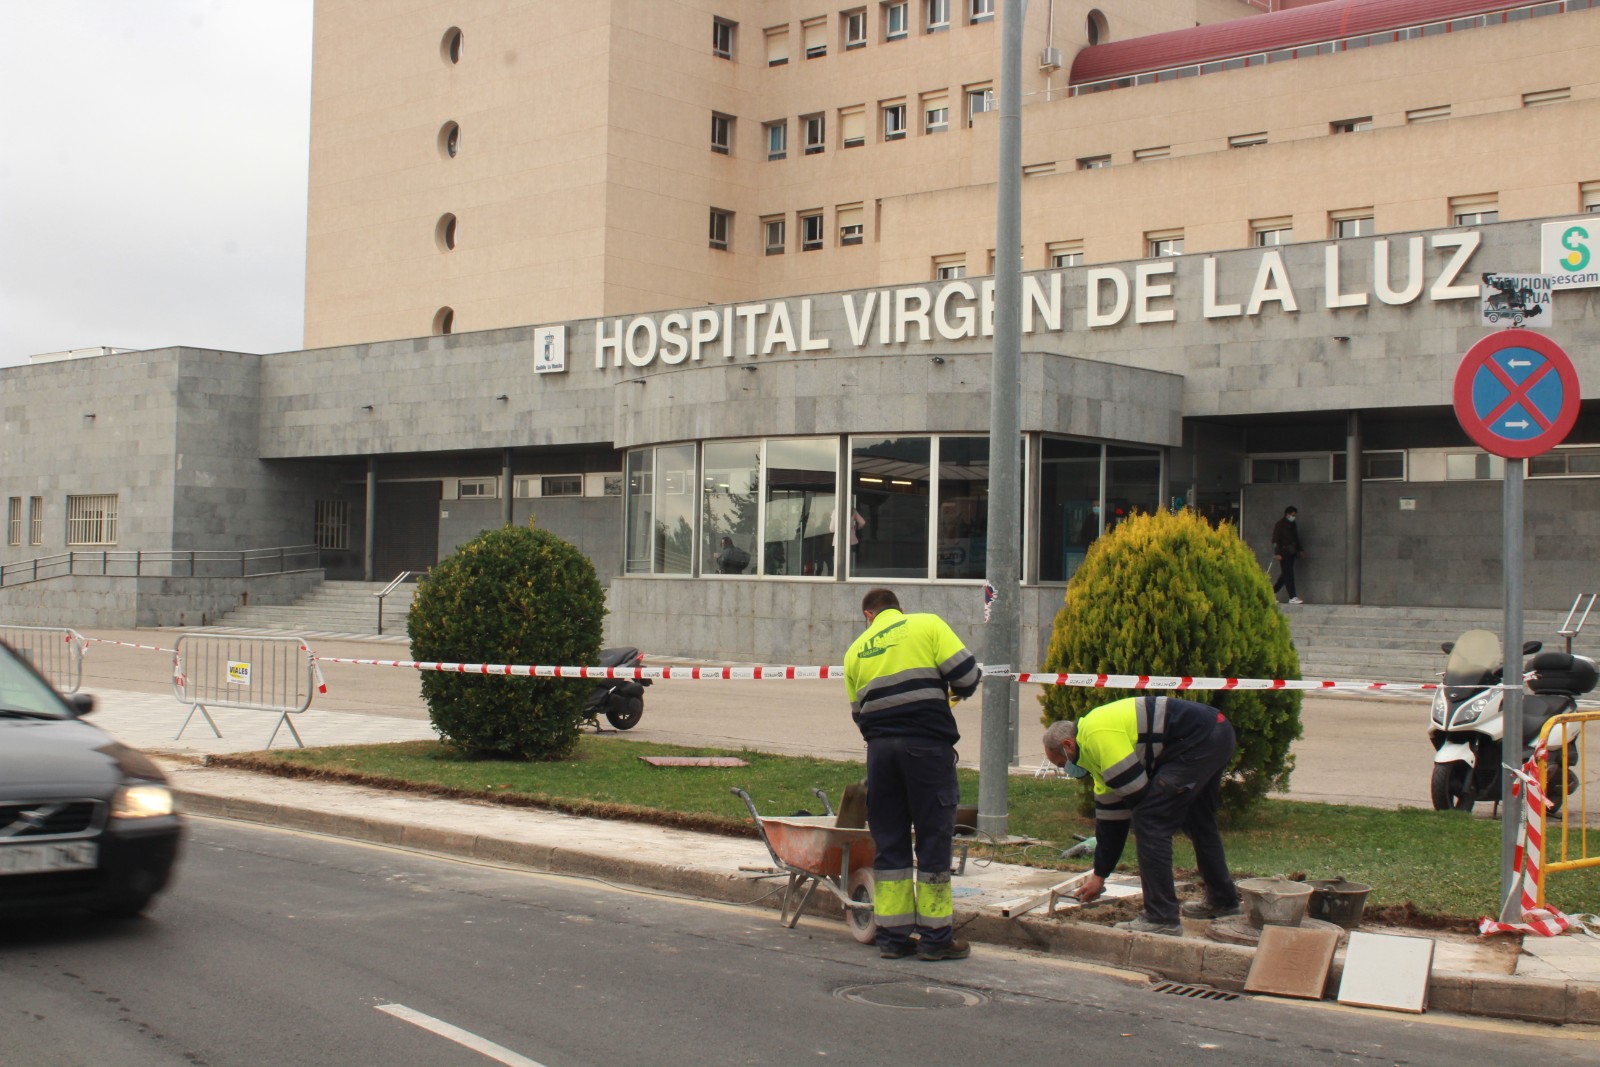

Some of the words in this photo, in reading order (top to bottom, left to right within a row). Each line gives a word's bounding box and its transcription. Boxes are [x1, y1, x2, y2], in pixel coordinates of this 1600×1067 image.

[595, 298, 832, 370] HOSPITAL
[1087, 262, 1177, 327] DE
[1202, 251, 1300, 319] LA
[1324, 231, 1483, 310] LUZ
[1552, 272, 1598, 285] sescam
